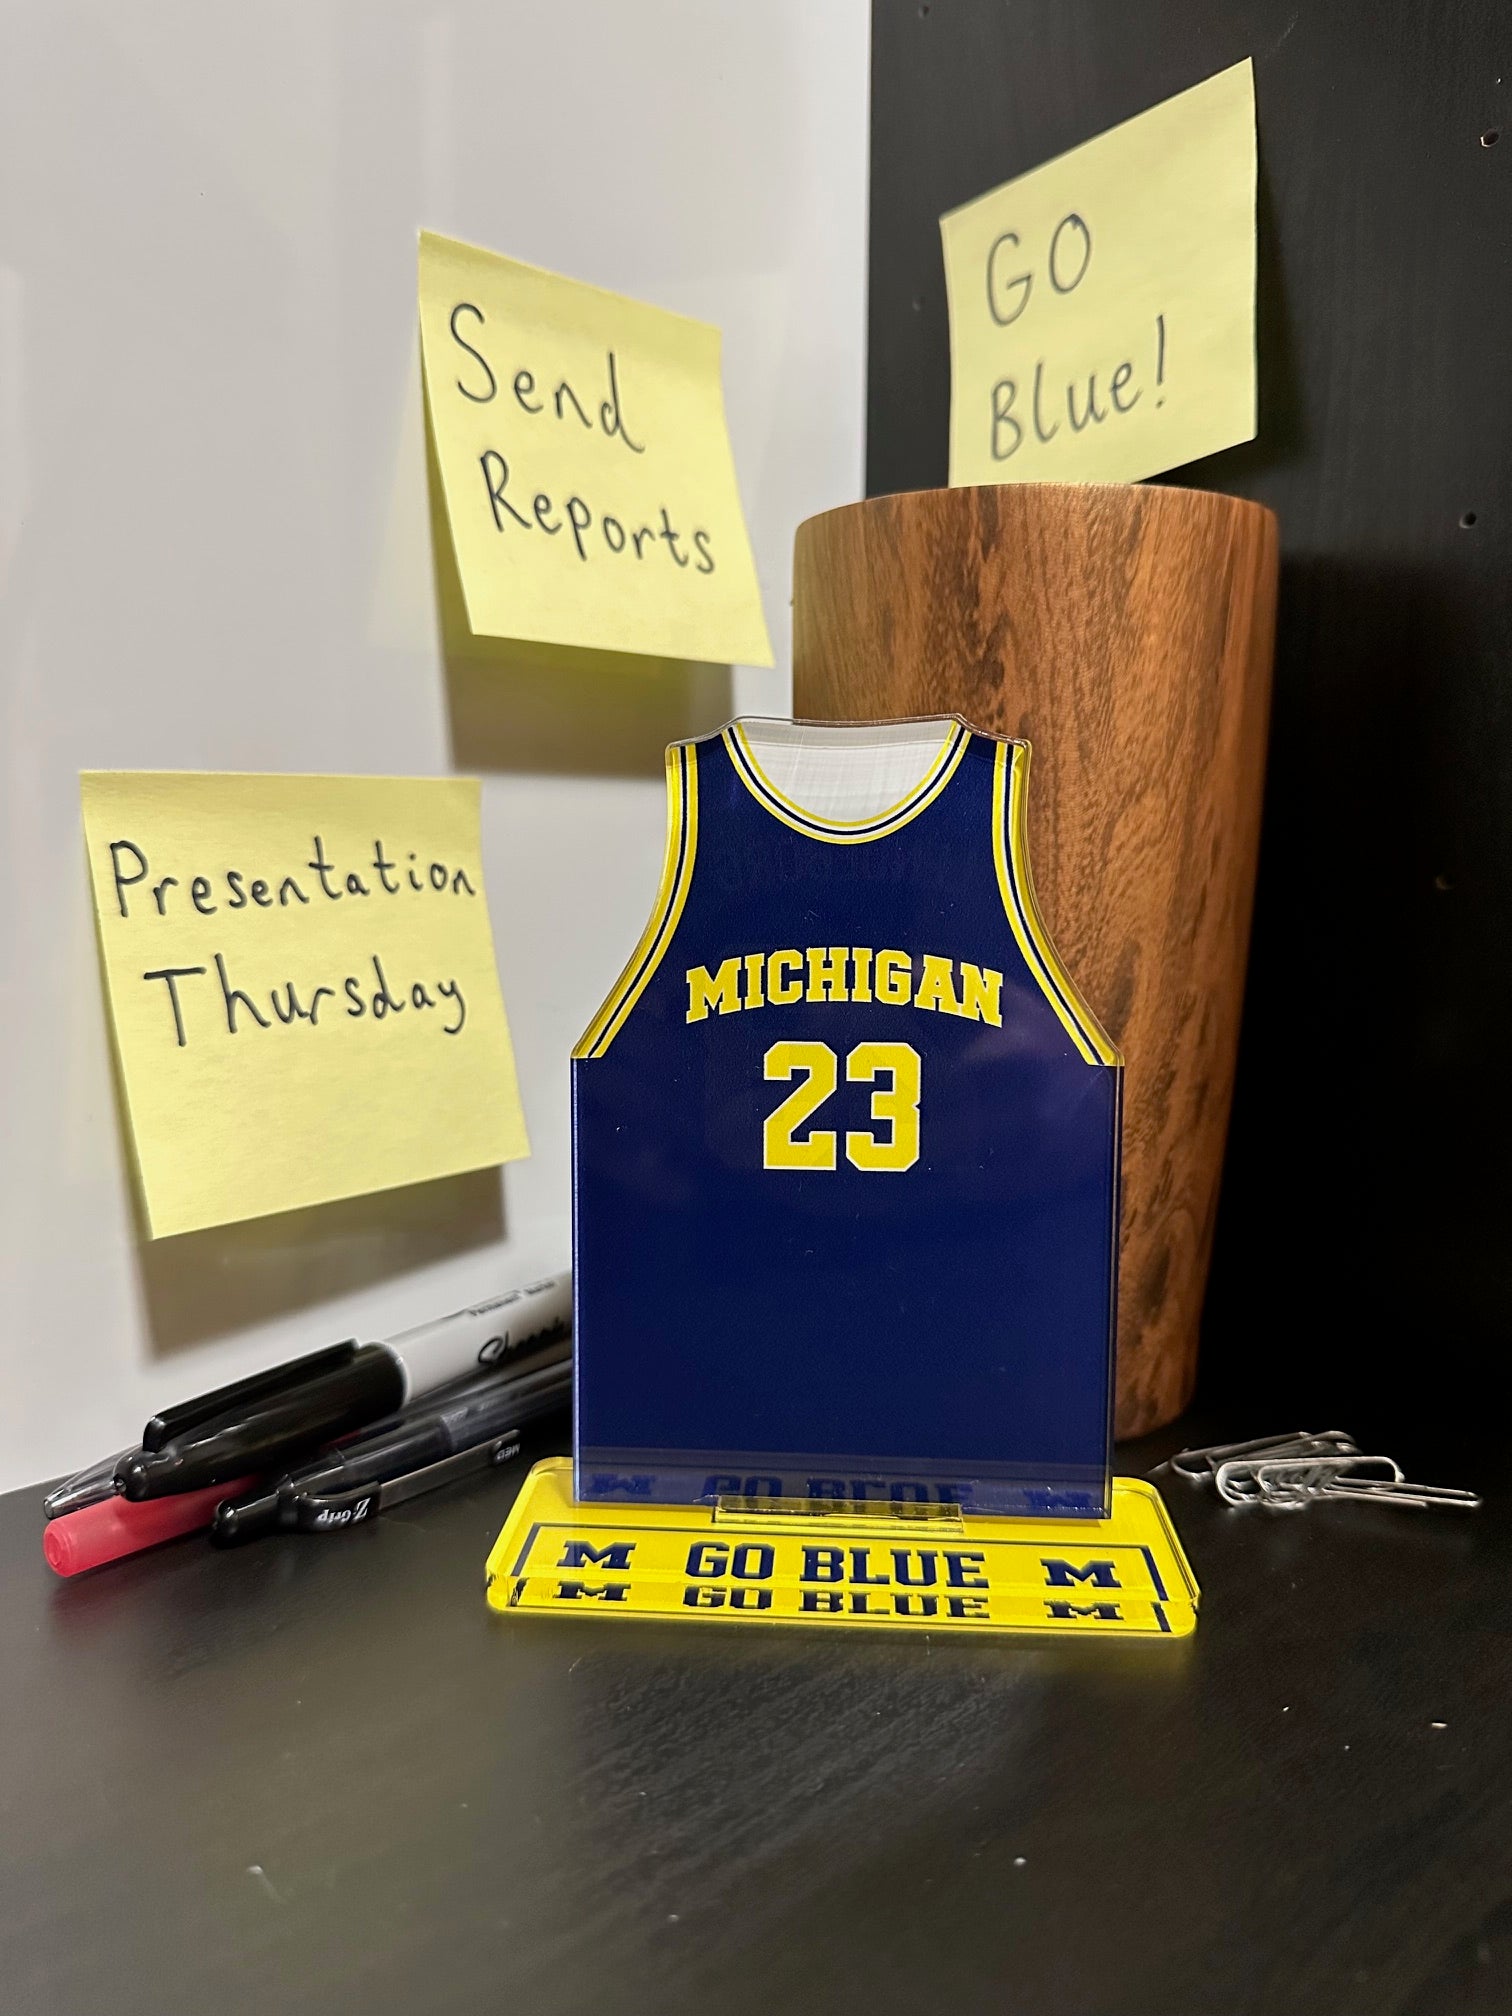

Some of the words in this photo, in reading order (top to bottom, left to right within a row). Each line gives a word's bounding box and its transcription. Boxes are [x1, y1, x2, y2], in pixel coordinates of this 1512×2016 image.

[449, 302, 646, 454] Send
[989, 314, 1167, 461] Blue!
[480, 449, 715, 575] Reports
[108, 835, 477, 918] Presentation
[143, 952, 466, 1047] Thursday
[685, 946, 1004, 1028] MICHIGAN
[763, 1040, 922, 1172] 23
[556, 1540, 637, 1570] M
[685, 1541, 775, 1579] GO
[800, 1544, 990, 1589] BLUE
[1040, 1558, 1122, 1588] M
